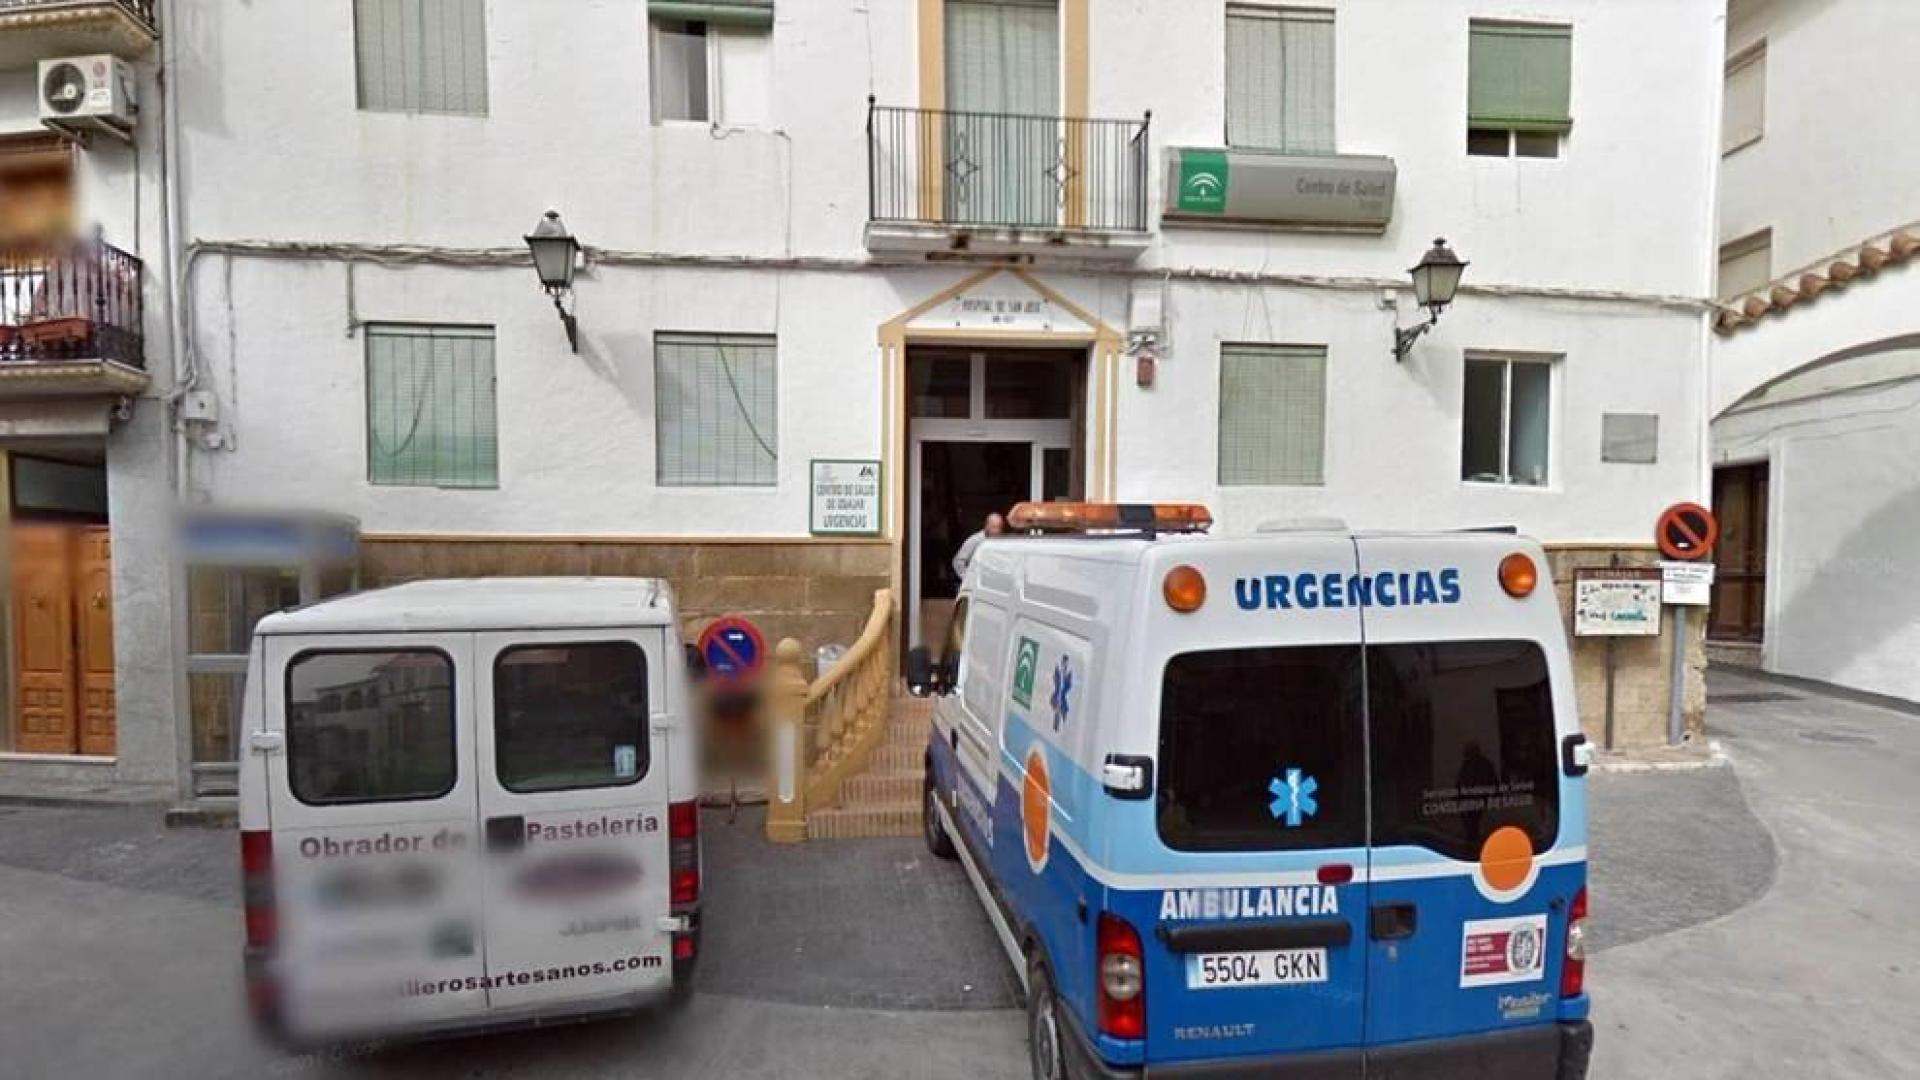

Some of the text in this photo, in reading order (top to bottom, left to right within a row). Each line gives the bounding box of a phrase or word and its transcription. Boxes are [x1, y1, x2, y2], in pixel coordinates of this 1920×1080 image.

[823, 515, 868, 529] URGENCIAS
[1235, 568, 1461, 611] URGENCIAS
[300, 812, 660, 860] Obrador de Pastelería
[1159, 886, 1339, 920] AMBULANCIA
[1202, 951, 1321, 984] 5504 GKN
[1174, 1023, 1256, 1041] RENAULT
